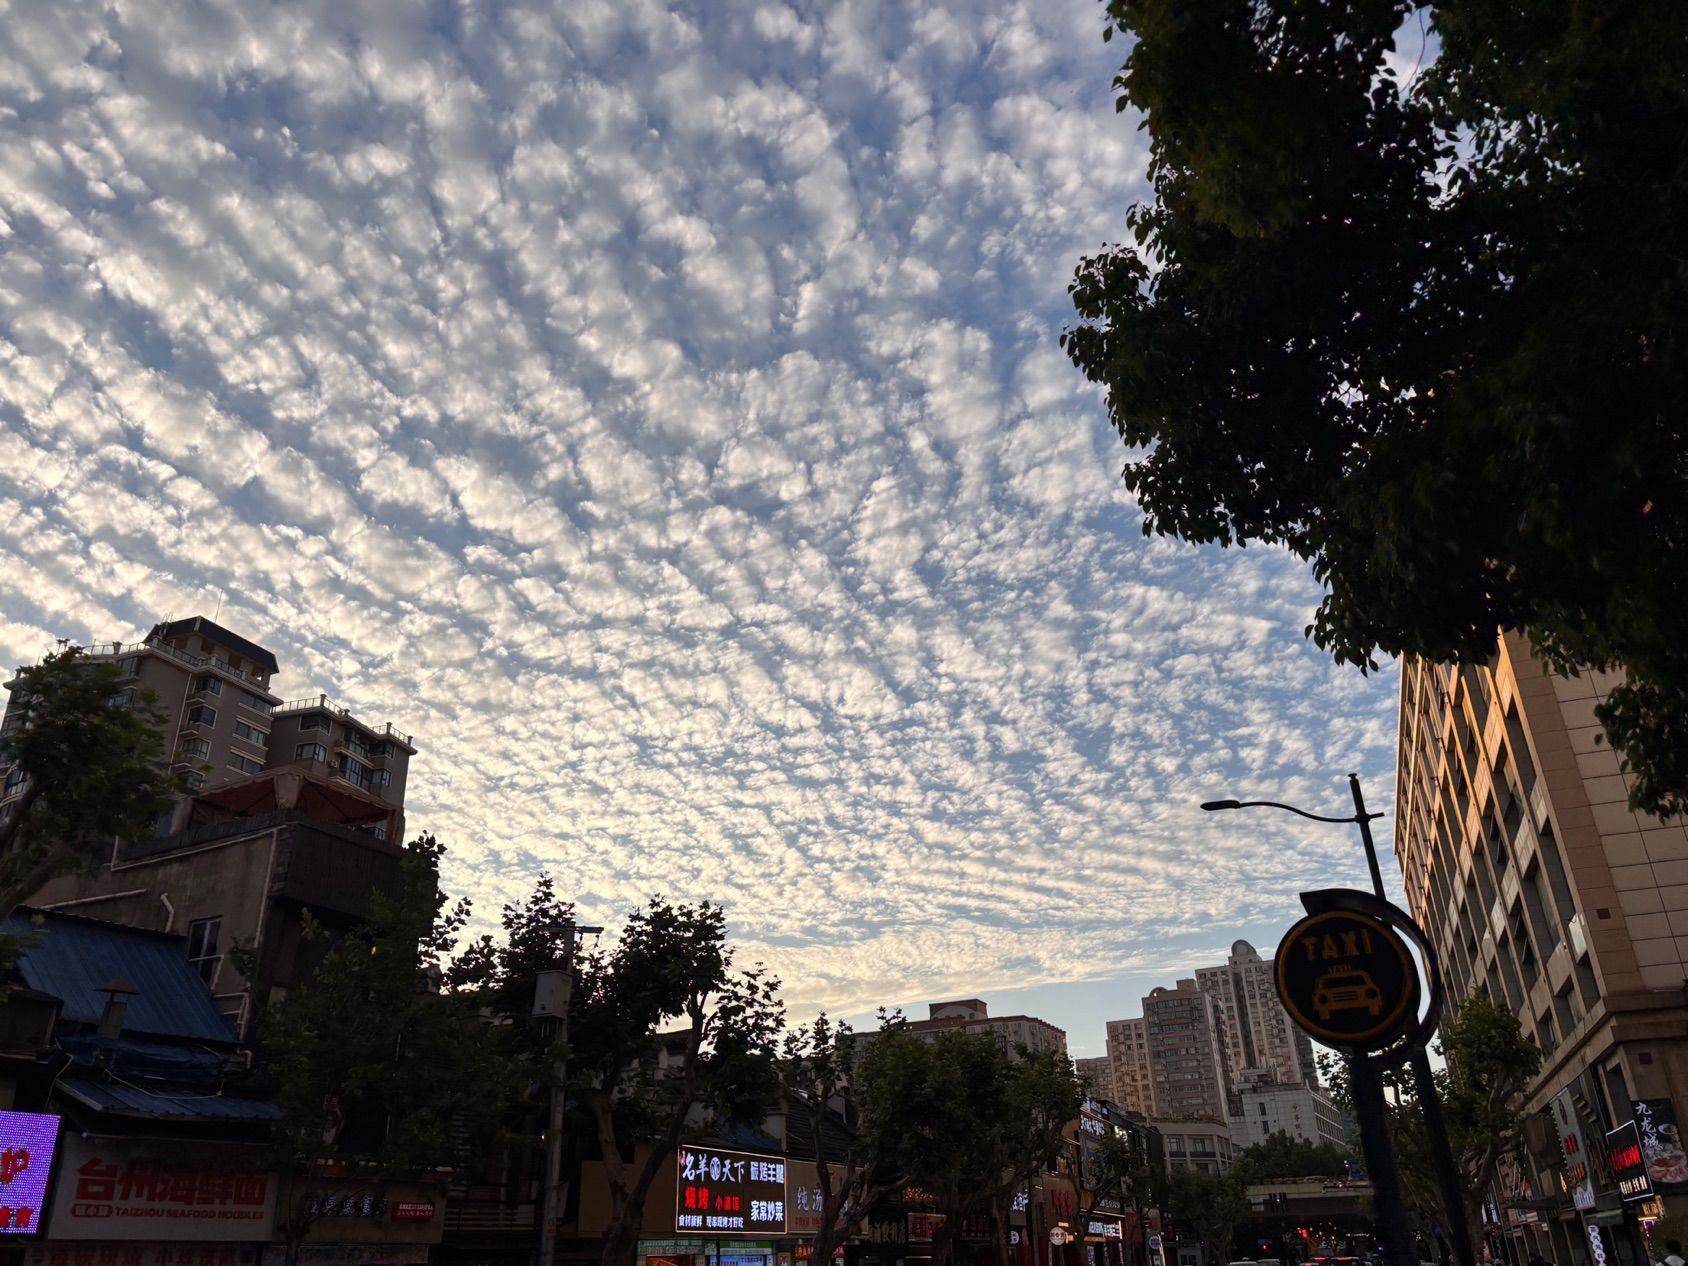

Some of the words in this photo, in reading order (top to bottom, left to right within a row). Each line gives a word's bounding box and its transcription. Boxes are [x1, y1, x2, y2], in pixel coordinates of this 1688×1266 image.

[1302, 928, 1374, 961] TAXI
[115, 1207, 164, 1218] TAIZHOU
[166, 1208, 216, 1219] SEAFOOD
[750, 1200, 784, 1222] 家常炒菜
